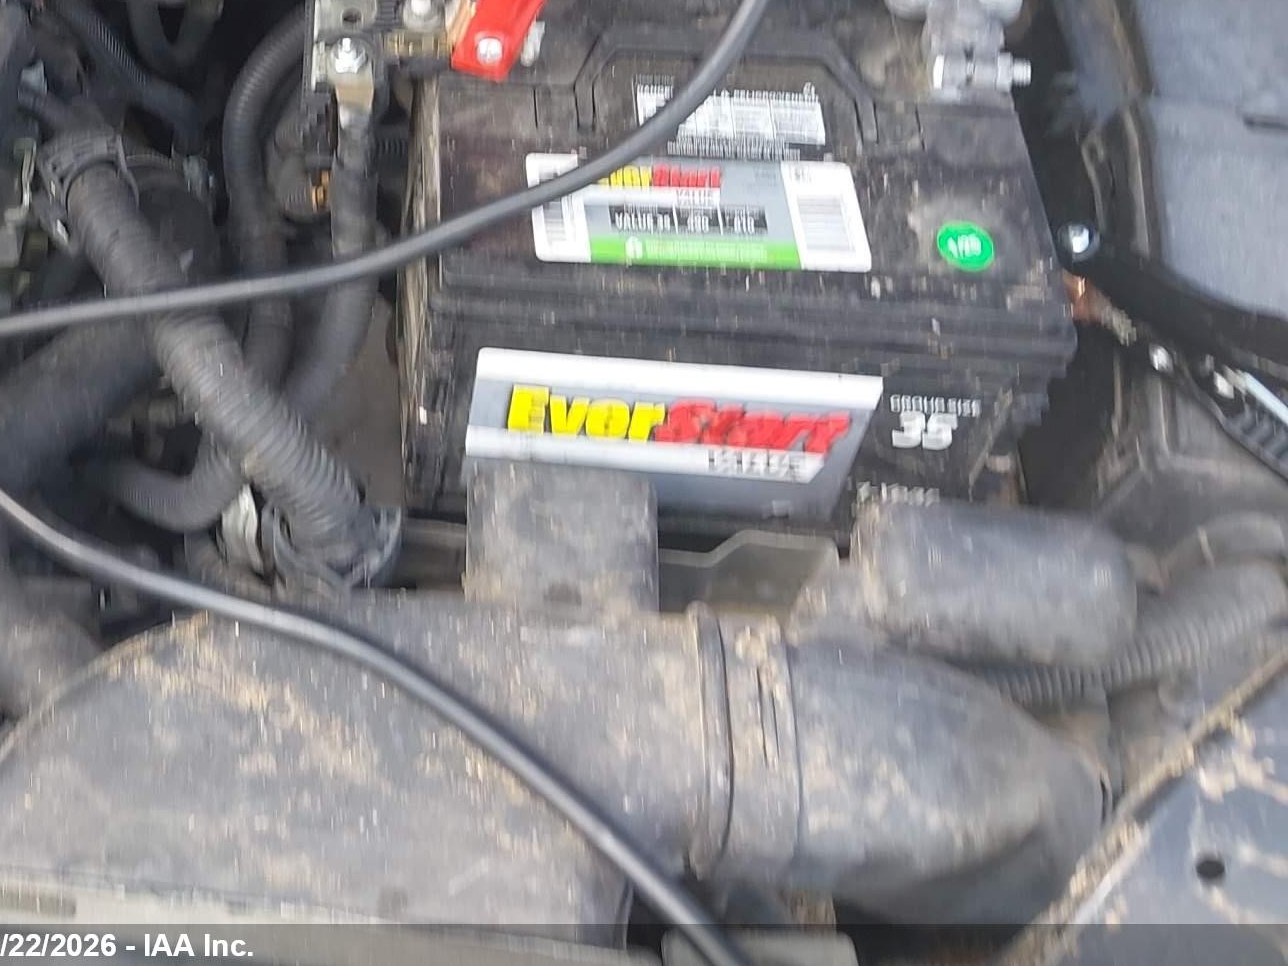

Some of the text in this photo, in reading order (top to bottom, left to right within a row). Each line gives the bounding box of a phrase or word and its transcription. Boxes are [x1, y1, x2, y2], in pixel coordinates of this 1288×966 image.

[507, 385, 854, 454] EverStart
[890, 394, 945, 415] GROUP
[892, 410, 959, 451] 35
